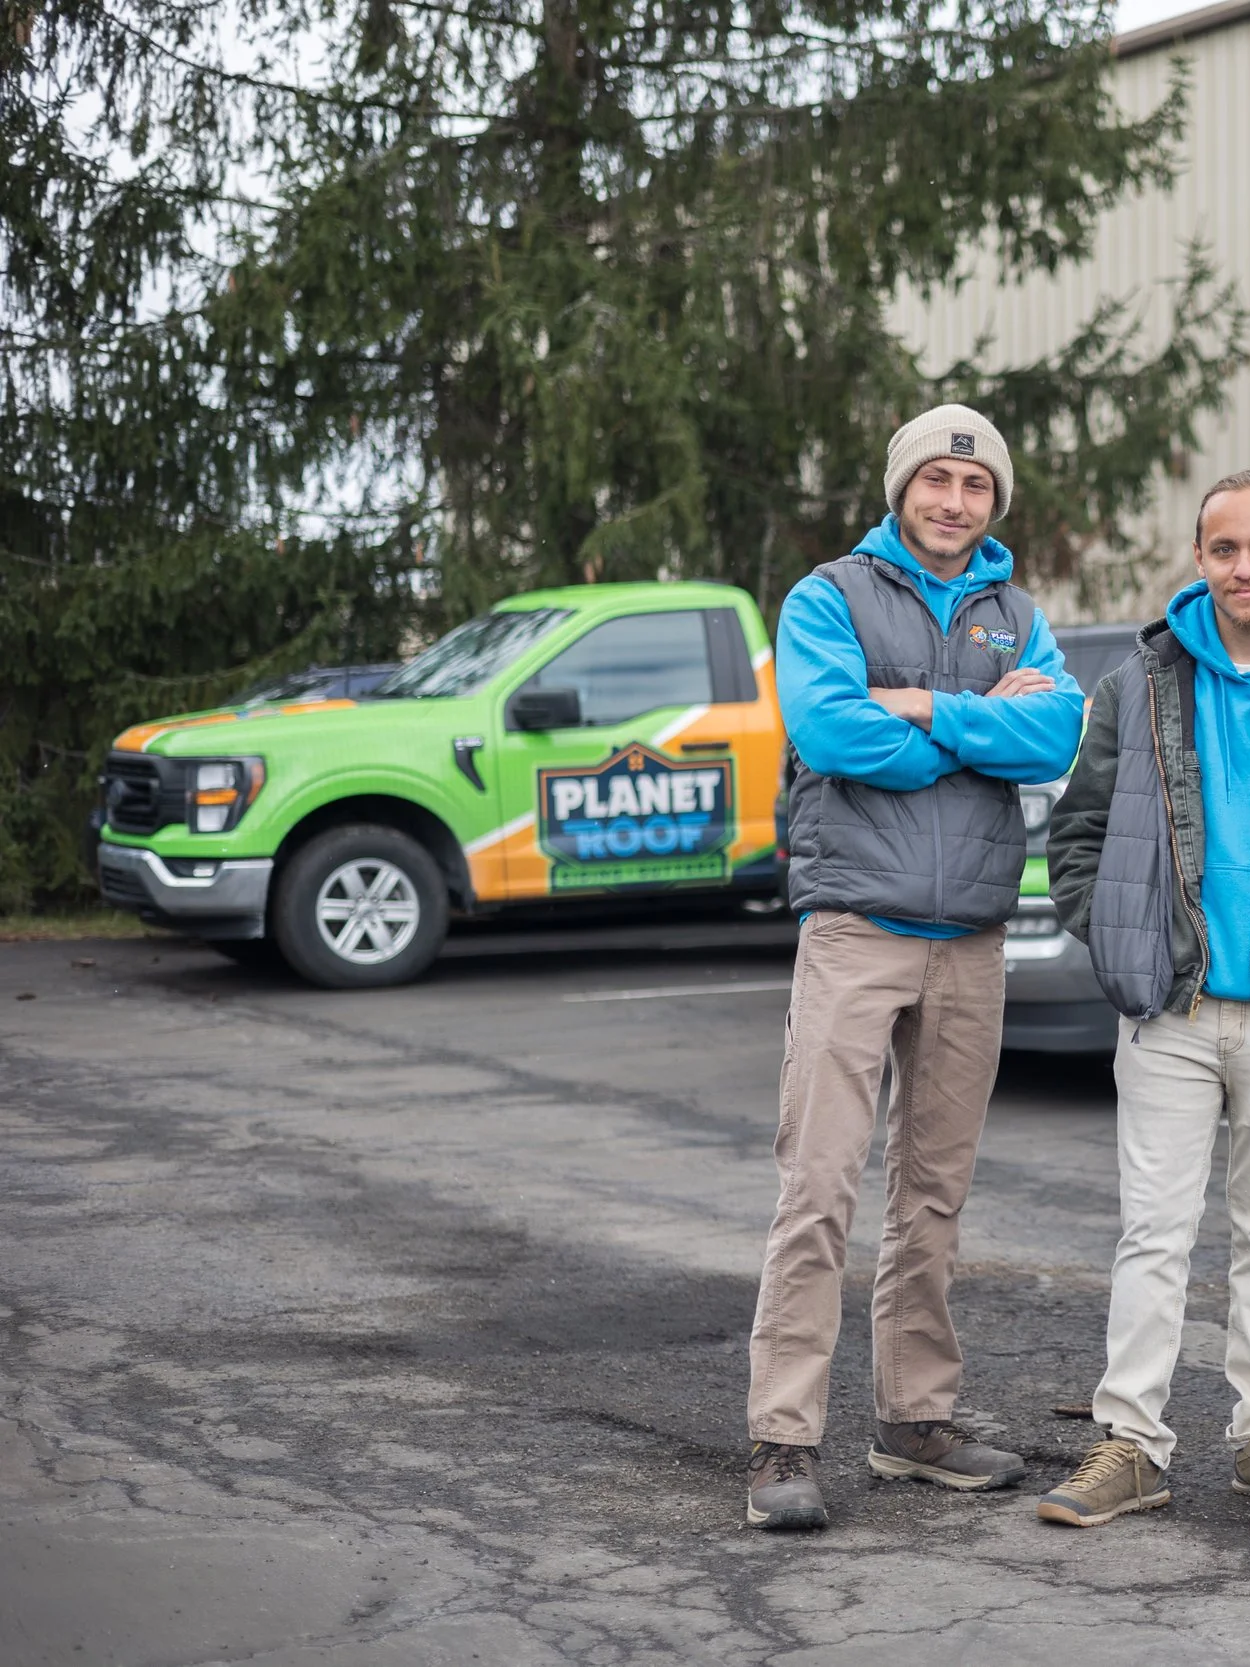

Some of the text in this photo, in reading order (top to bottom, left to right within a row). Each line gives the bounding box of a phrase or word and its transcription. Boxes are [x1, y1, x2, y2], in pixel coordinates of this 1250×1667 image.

[991, 633, 1015, 642] PLANET
[552, 770, 720, 820] PLANET
[562, 813, 711, 859] ROOF
